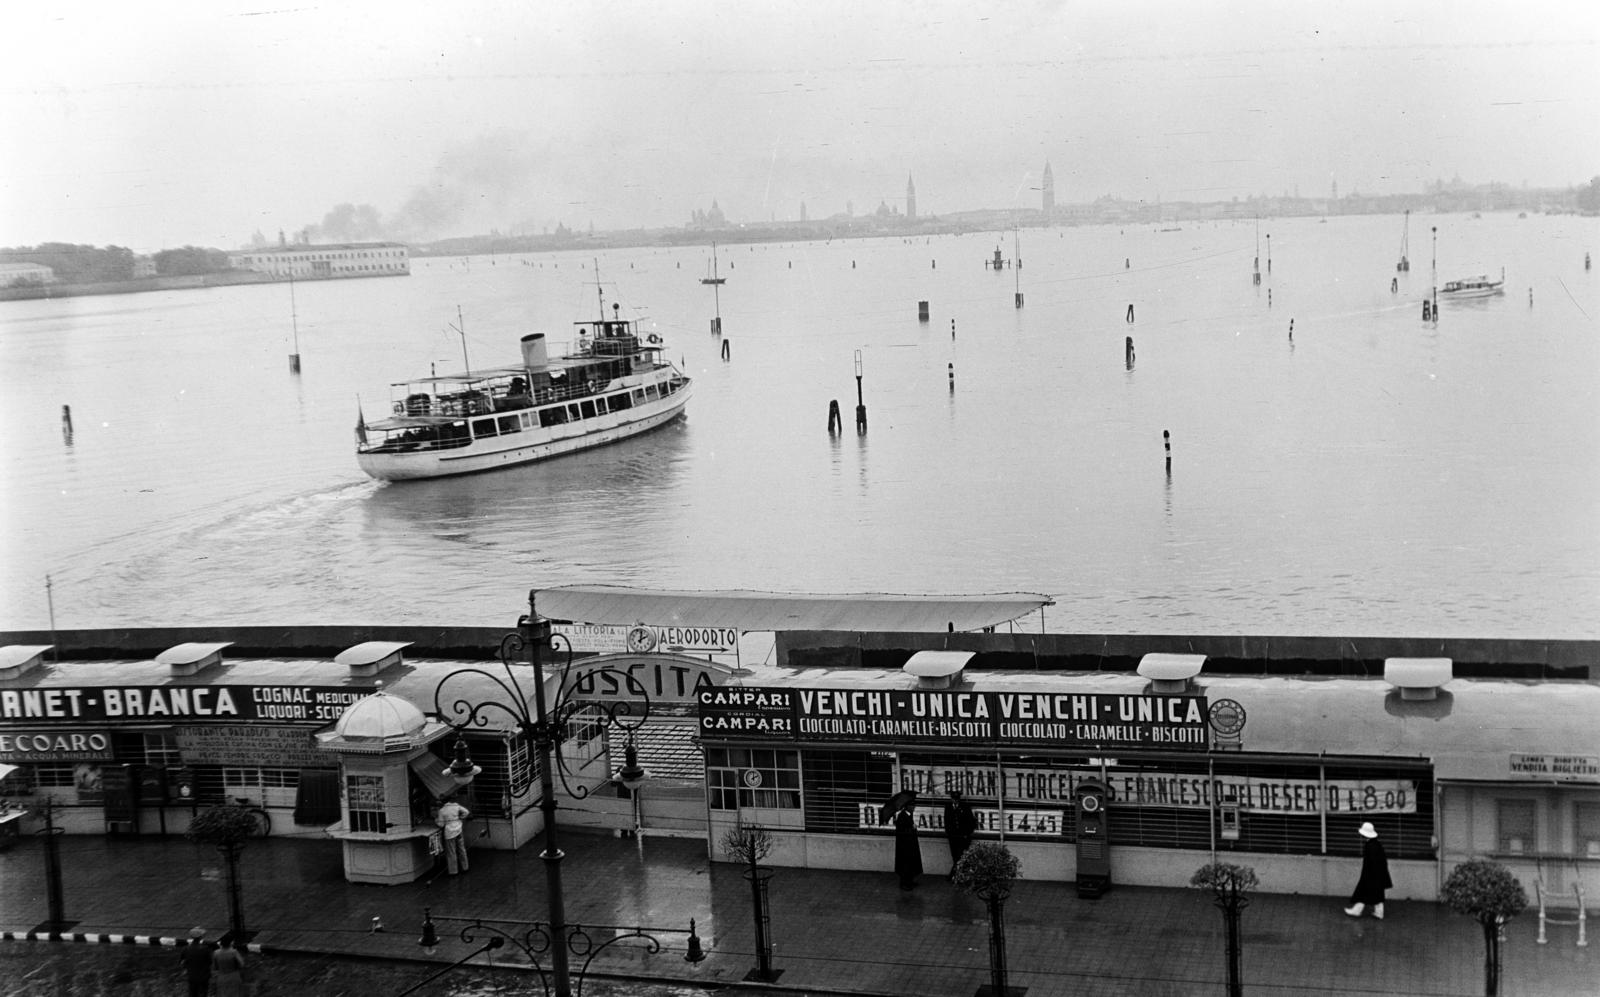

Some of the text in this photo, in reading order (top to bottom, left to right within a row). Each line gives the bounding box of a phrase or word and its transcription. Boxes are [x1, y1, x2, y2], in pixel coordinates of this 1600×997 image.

[660, 628, 736, 646] AEROPORTO
[576, 663, 713, 697] USCITA
[253, 687, 313, 703] COGNAC
[701, 692, 790, 706] CAMPARI
[257, 705, 306, 719] LIQUORI
[703, 717, 791, 730] CAMPARI
[1000, 723, 1205, 743] CIOCCOLATO CARAMELLE BISCOTTI
[25, 752, 59, 760] ACQUA
[62, 752, 112, 760] MINERALE
[900, 768, 935, 795] GITA
[1015, 772, 1097, 800] TORCEL
[1259, 783, 1340, 812] DESERO
[1006, 813, 1056, 833] 14.45
